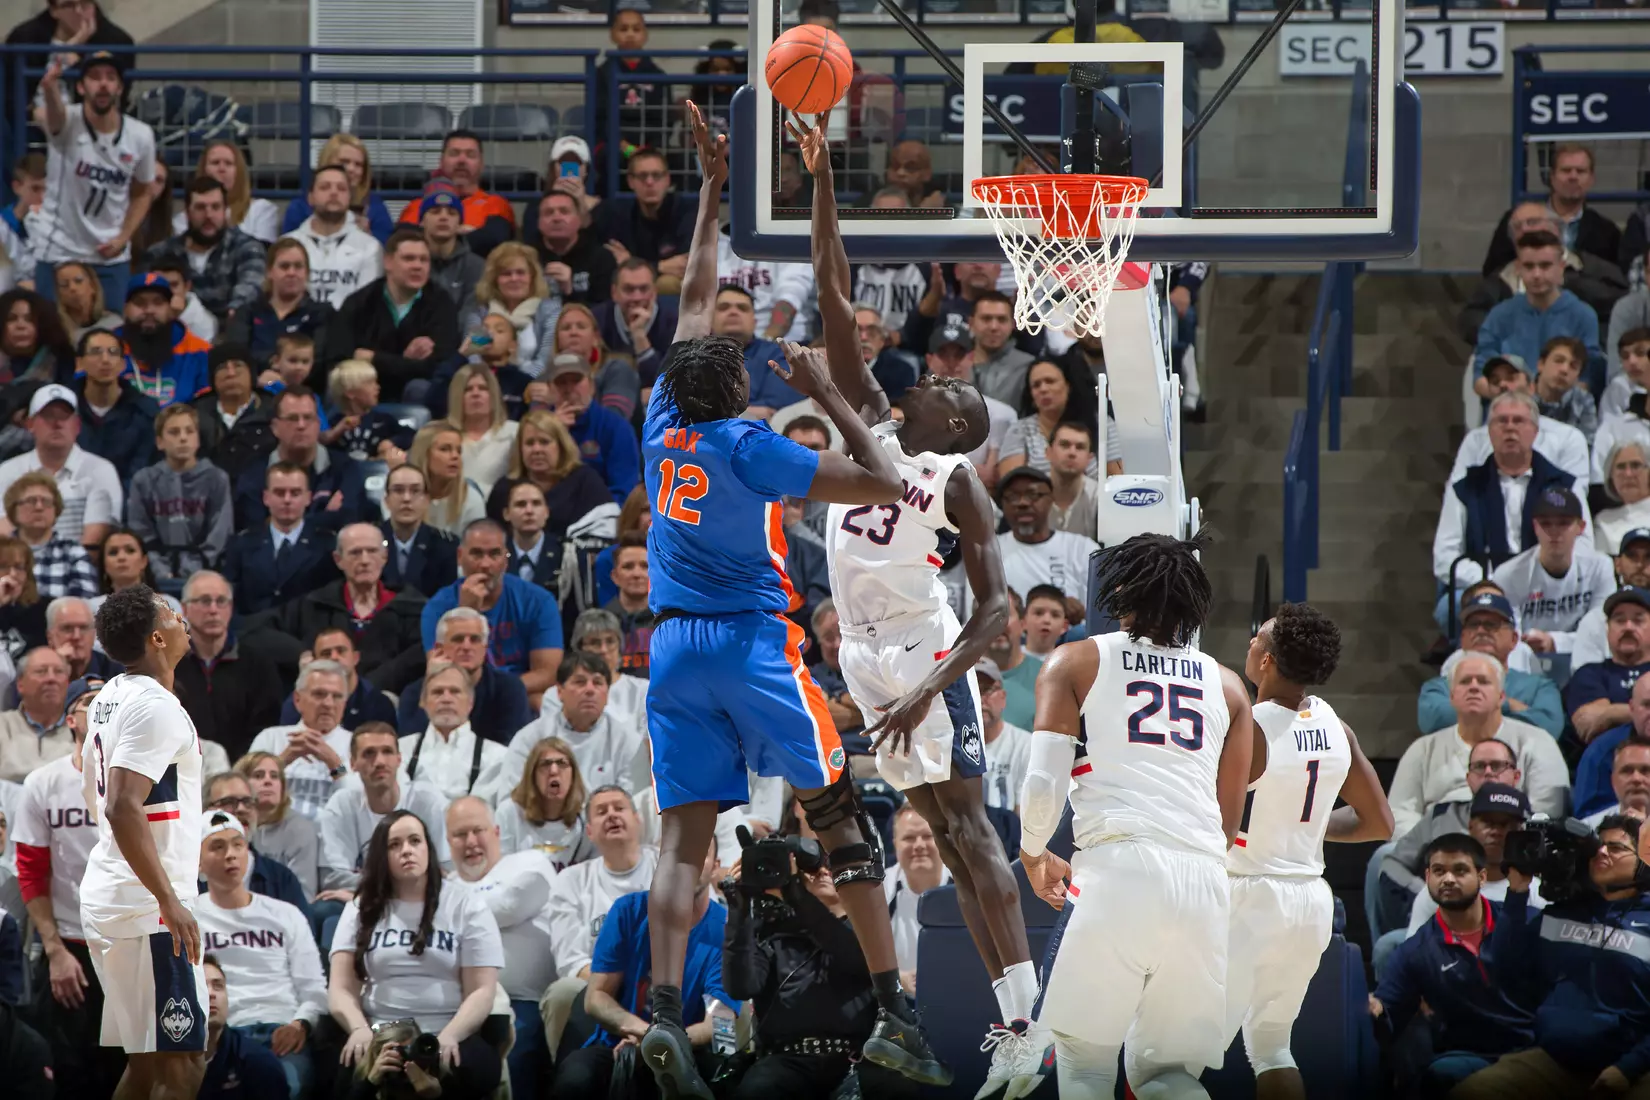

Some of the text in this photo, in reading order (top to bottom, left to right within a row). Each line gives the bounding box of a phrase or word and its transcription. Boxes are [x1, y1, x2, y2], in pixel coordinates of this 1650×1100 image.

[1287, 26, 1498, 70] SEC 215
[949, 93, 1026, 124] SC
[1530, 92, 1609, 124] SEC
[663, 427, 705, 454] GAK
[657, 458, 710, 526] 12
[1114, 492, 1161, 501] SNA
[840, 503, 902, 546] 23
[1122, 650, 1203, 681] CARLTON
[1126, 680, 1204, 752] 25
[1293, 728, 1331, 752] VITAL
[1300, 759, 1320, 823] 1
[1490, 793, 1520, 808] UCONN
[1560, 923, 1635, 950] UCONN
